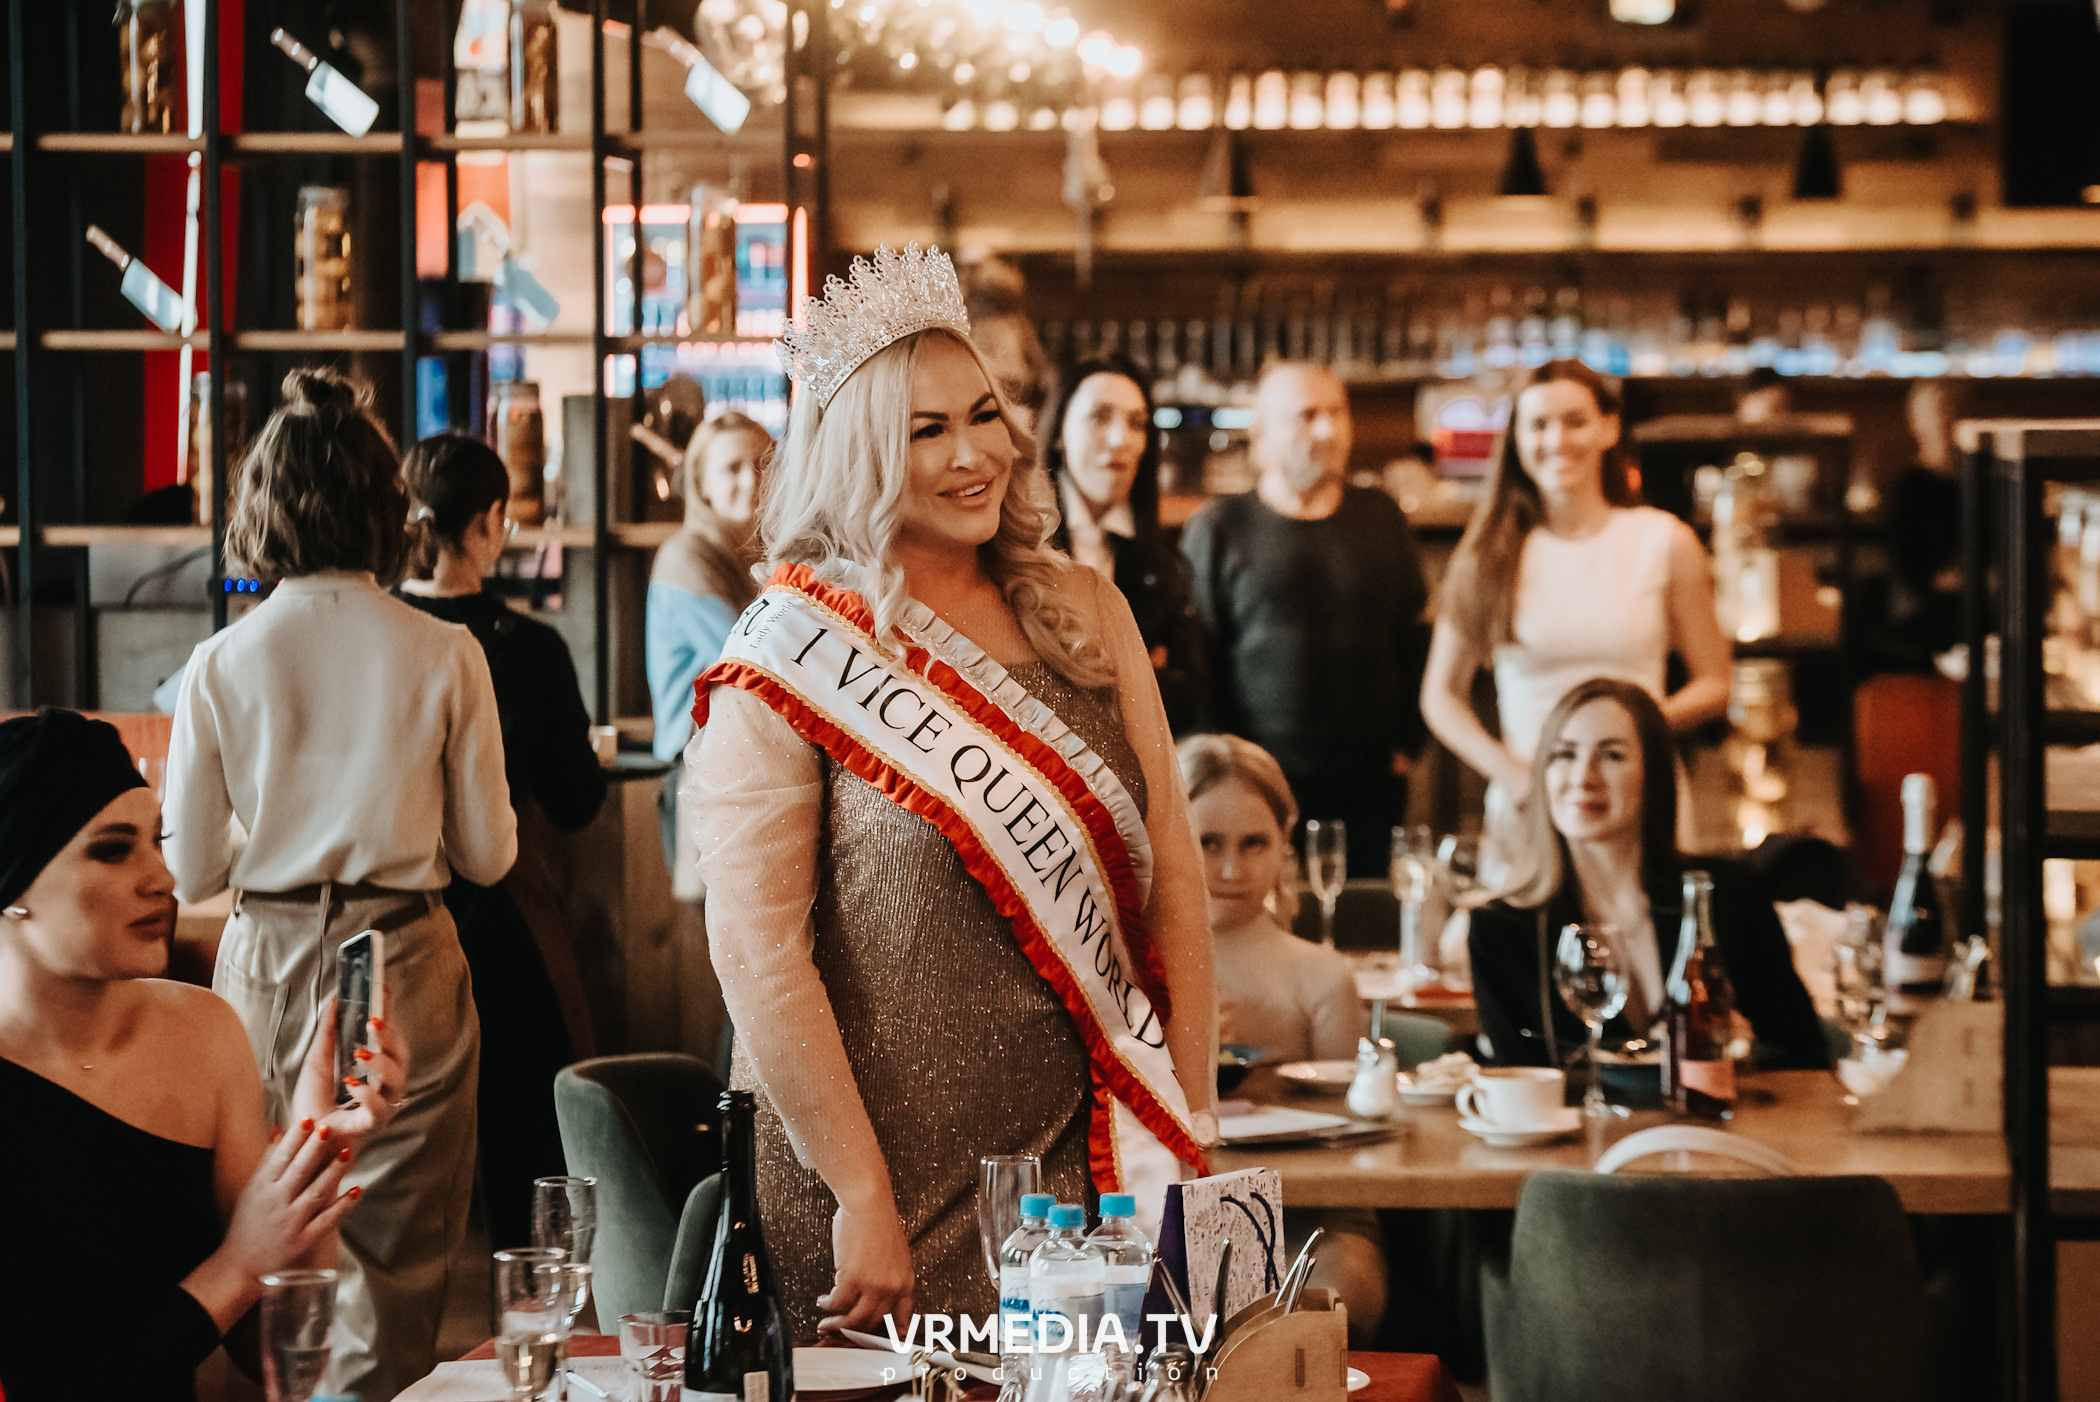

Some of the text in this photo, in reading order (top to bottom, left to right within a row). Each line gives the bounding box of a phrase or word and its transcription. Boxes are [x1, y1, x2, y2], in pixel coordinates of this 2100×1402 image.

[750, 600, 797, 649] Lady World
[837, 646, 953, 753] VICE
[951, 744, 1084, 903] QUEEN
[1074, 886, 1166, 1049] WORLD
